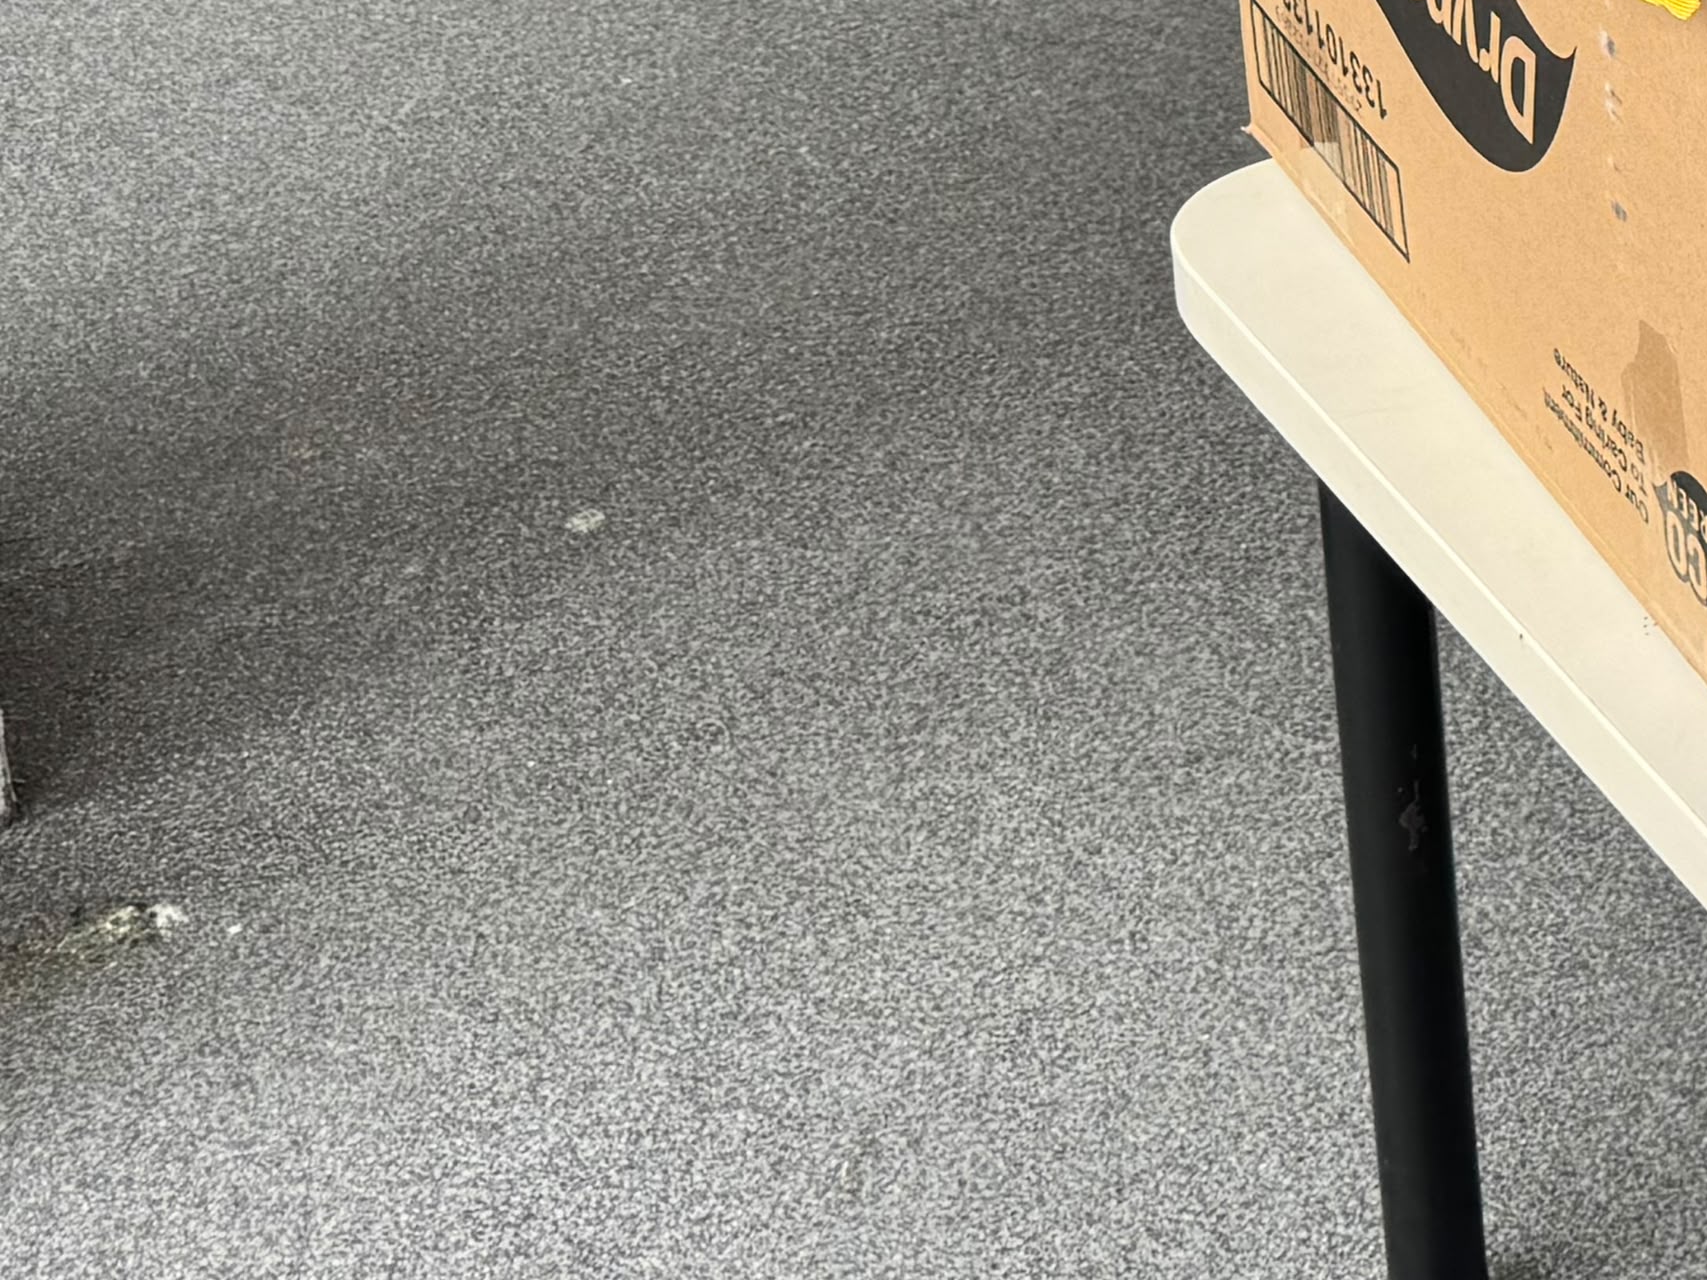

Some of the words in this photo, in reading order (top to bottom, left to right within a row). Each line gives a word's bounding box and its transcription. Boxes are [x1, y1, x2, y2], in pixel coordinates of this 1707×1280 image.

[1552, 347, 1596, 405] Nature
[1561, 384, 1583, 423] For
[1542, 386, 1623, 494] Commitment
[1584, 405, 1628, 473] Caring
[1611, 409, 1647, 467] Baby
[1625, 484, 1650, 525] Our
[1629, 465, 1649, 498] To
